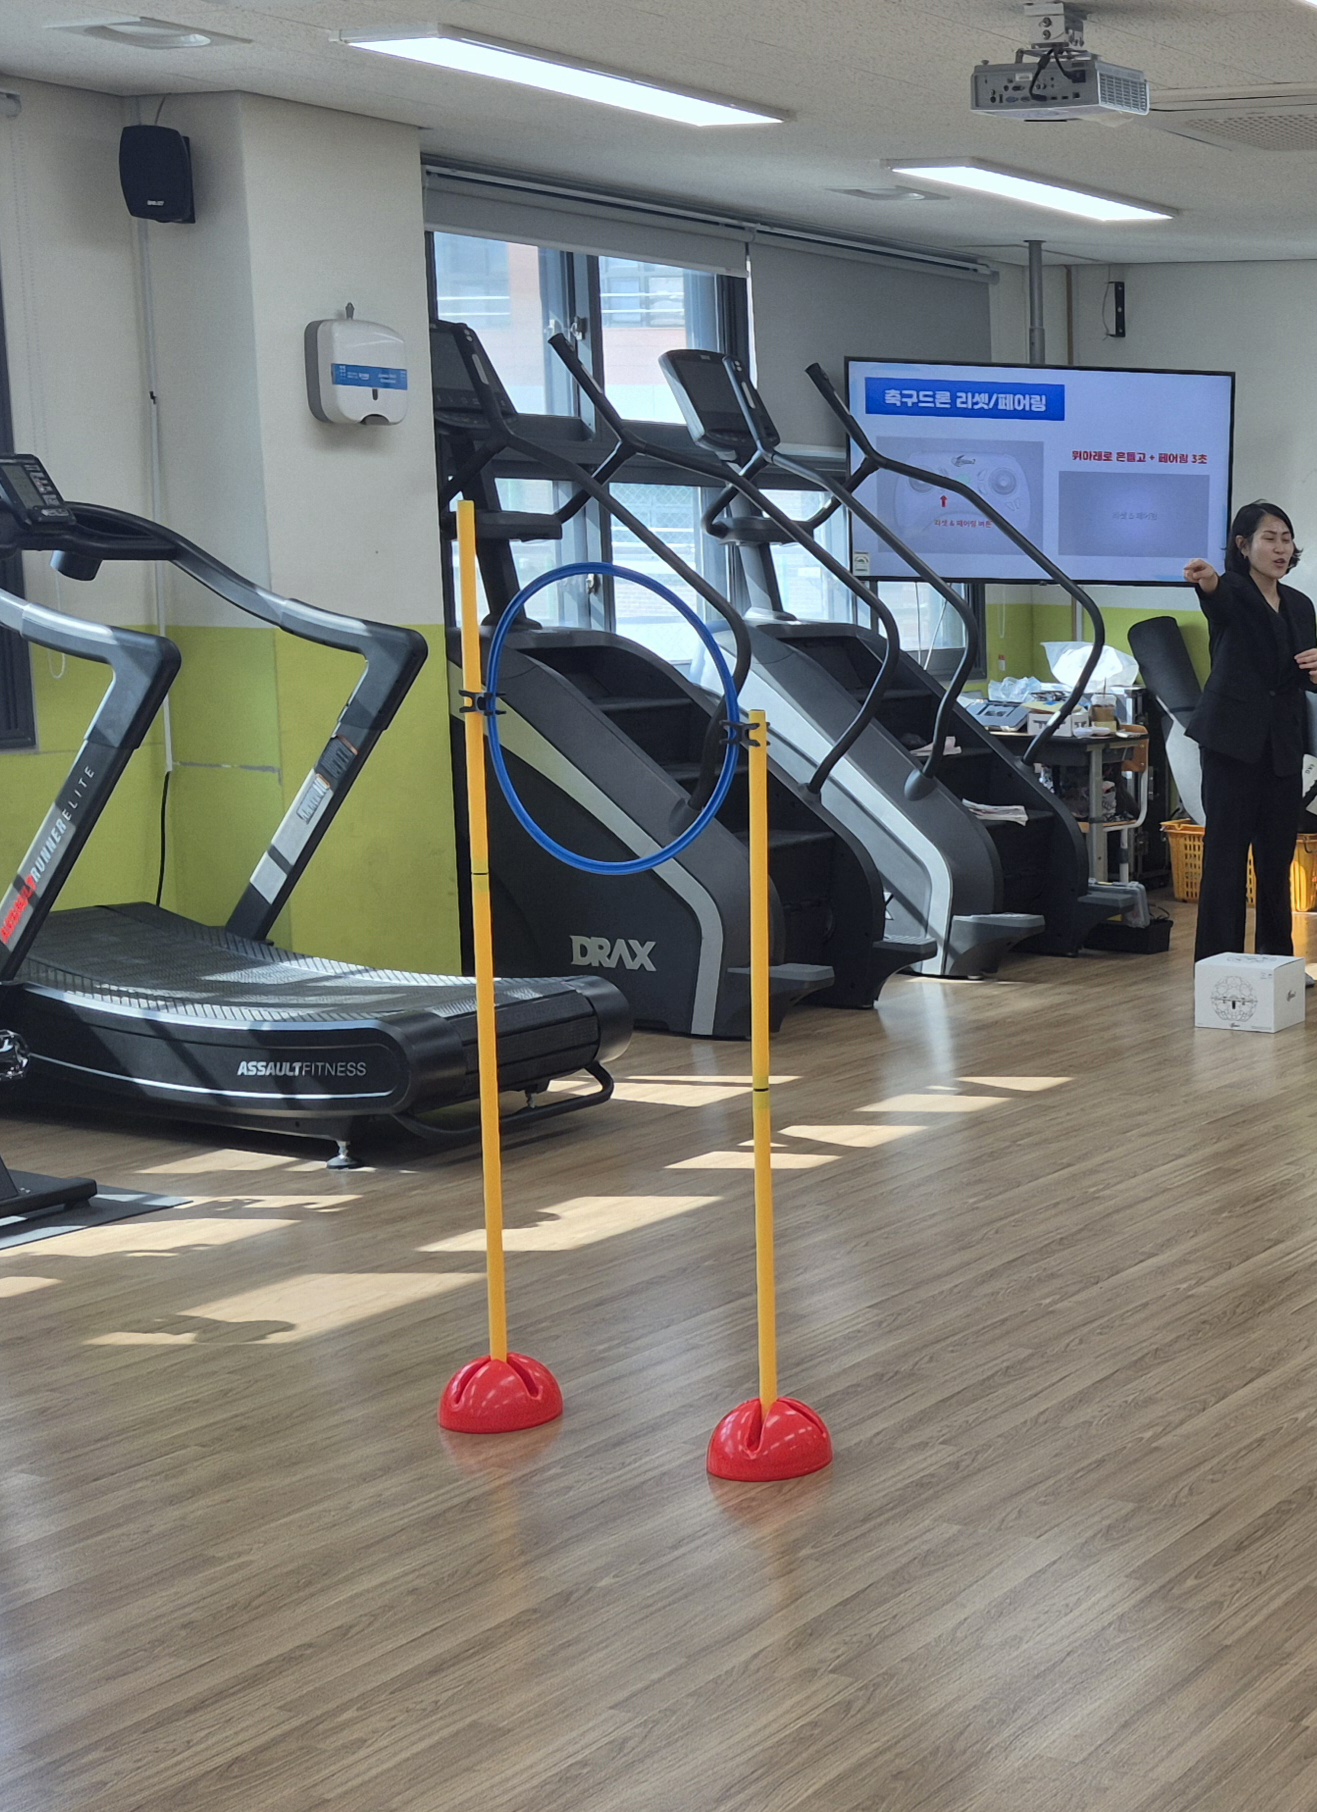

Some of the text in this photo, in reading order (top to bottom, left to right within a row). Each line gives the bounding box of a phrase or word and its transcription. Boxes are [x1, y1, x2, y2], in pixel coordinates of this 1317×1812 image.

[884, 389, 1046, 412] 축구드론 리셋/페어링
[1072, 450, 1113, 462] 위아래로
[1158, 452, 1189, 464] 페어링
[569, 935, 657, 972] DRAX
